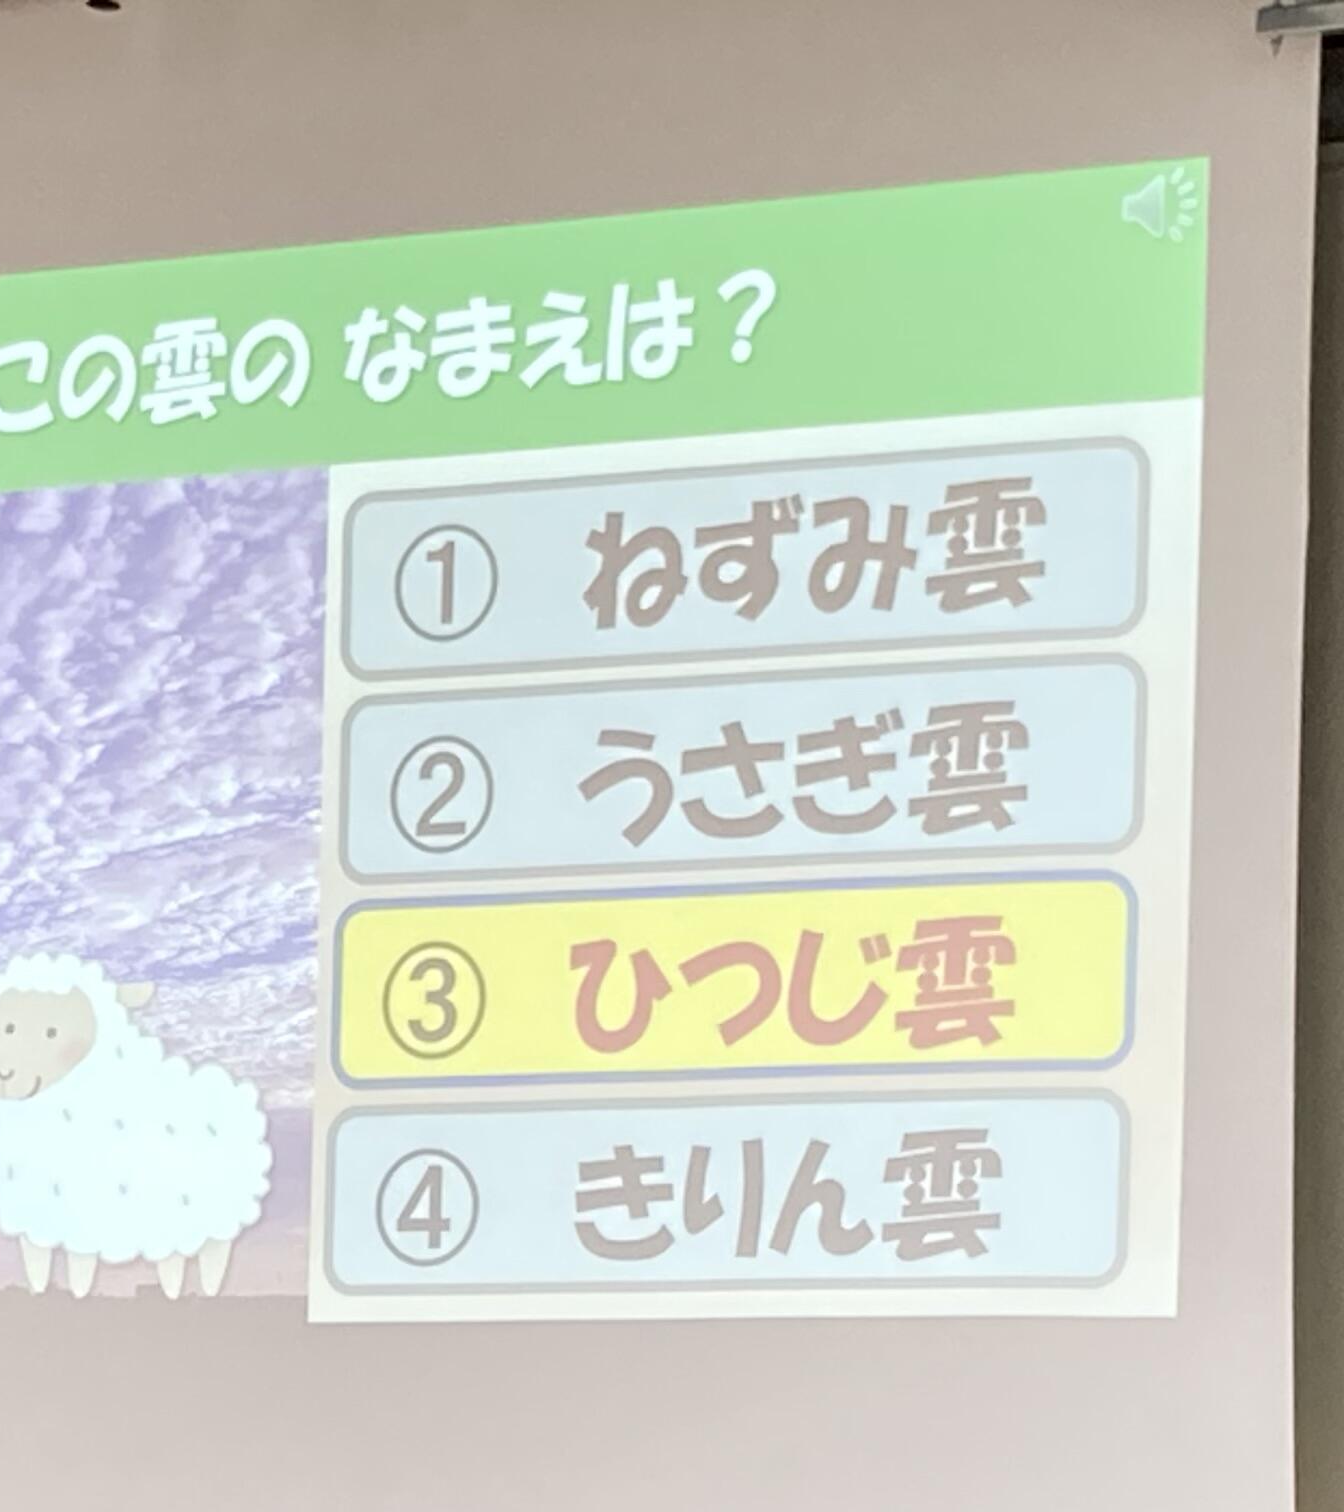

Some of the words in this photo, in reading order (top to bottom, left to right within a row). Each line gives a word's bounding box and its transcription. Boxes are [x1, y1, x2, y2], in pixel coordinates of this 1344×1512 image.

[342, 268, 778, 403] なまえは？
[582, 475, 1048, 631] ねずみ雲
[577, 699, 1030, 848] うさぎ雲
[569, 914, 1018, 1054] ひつじ雲
[573, 1127, 1003, 1262] きりん雲
